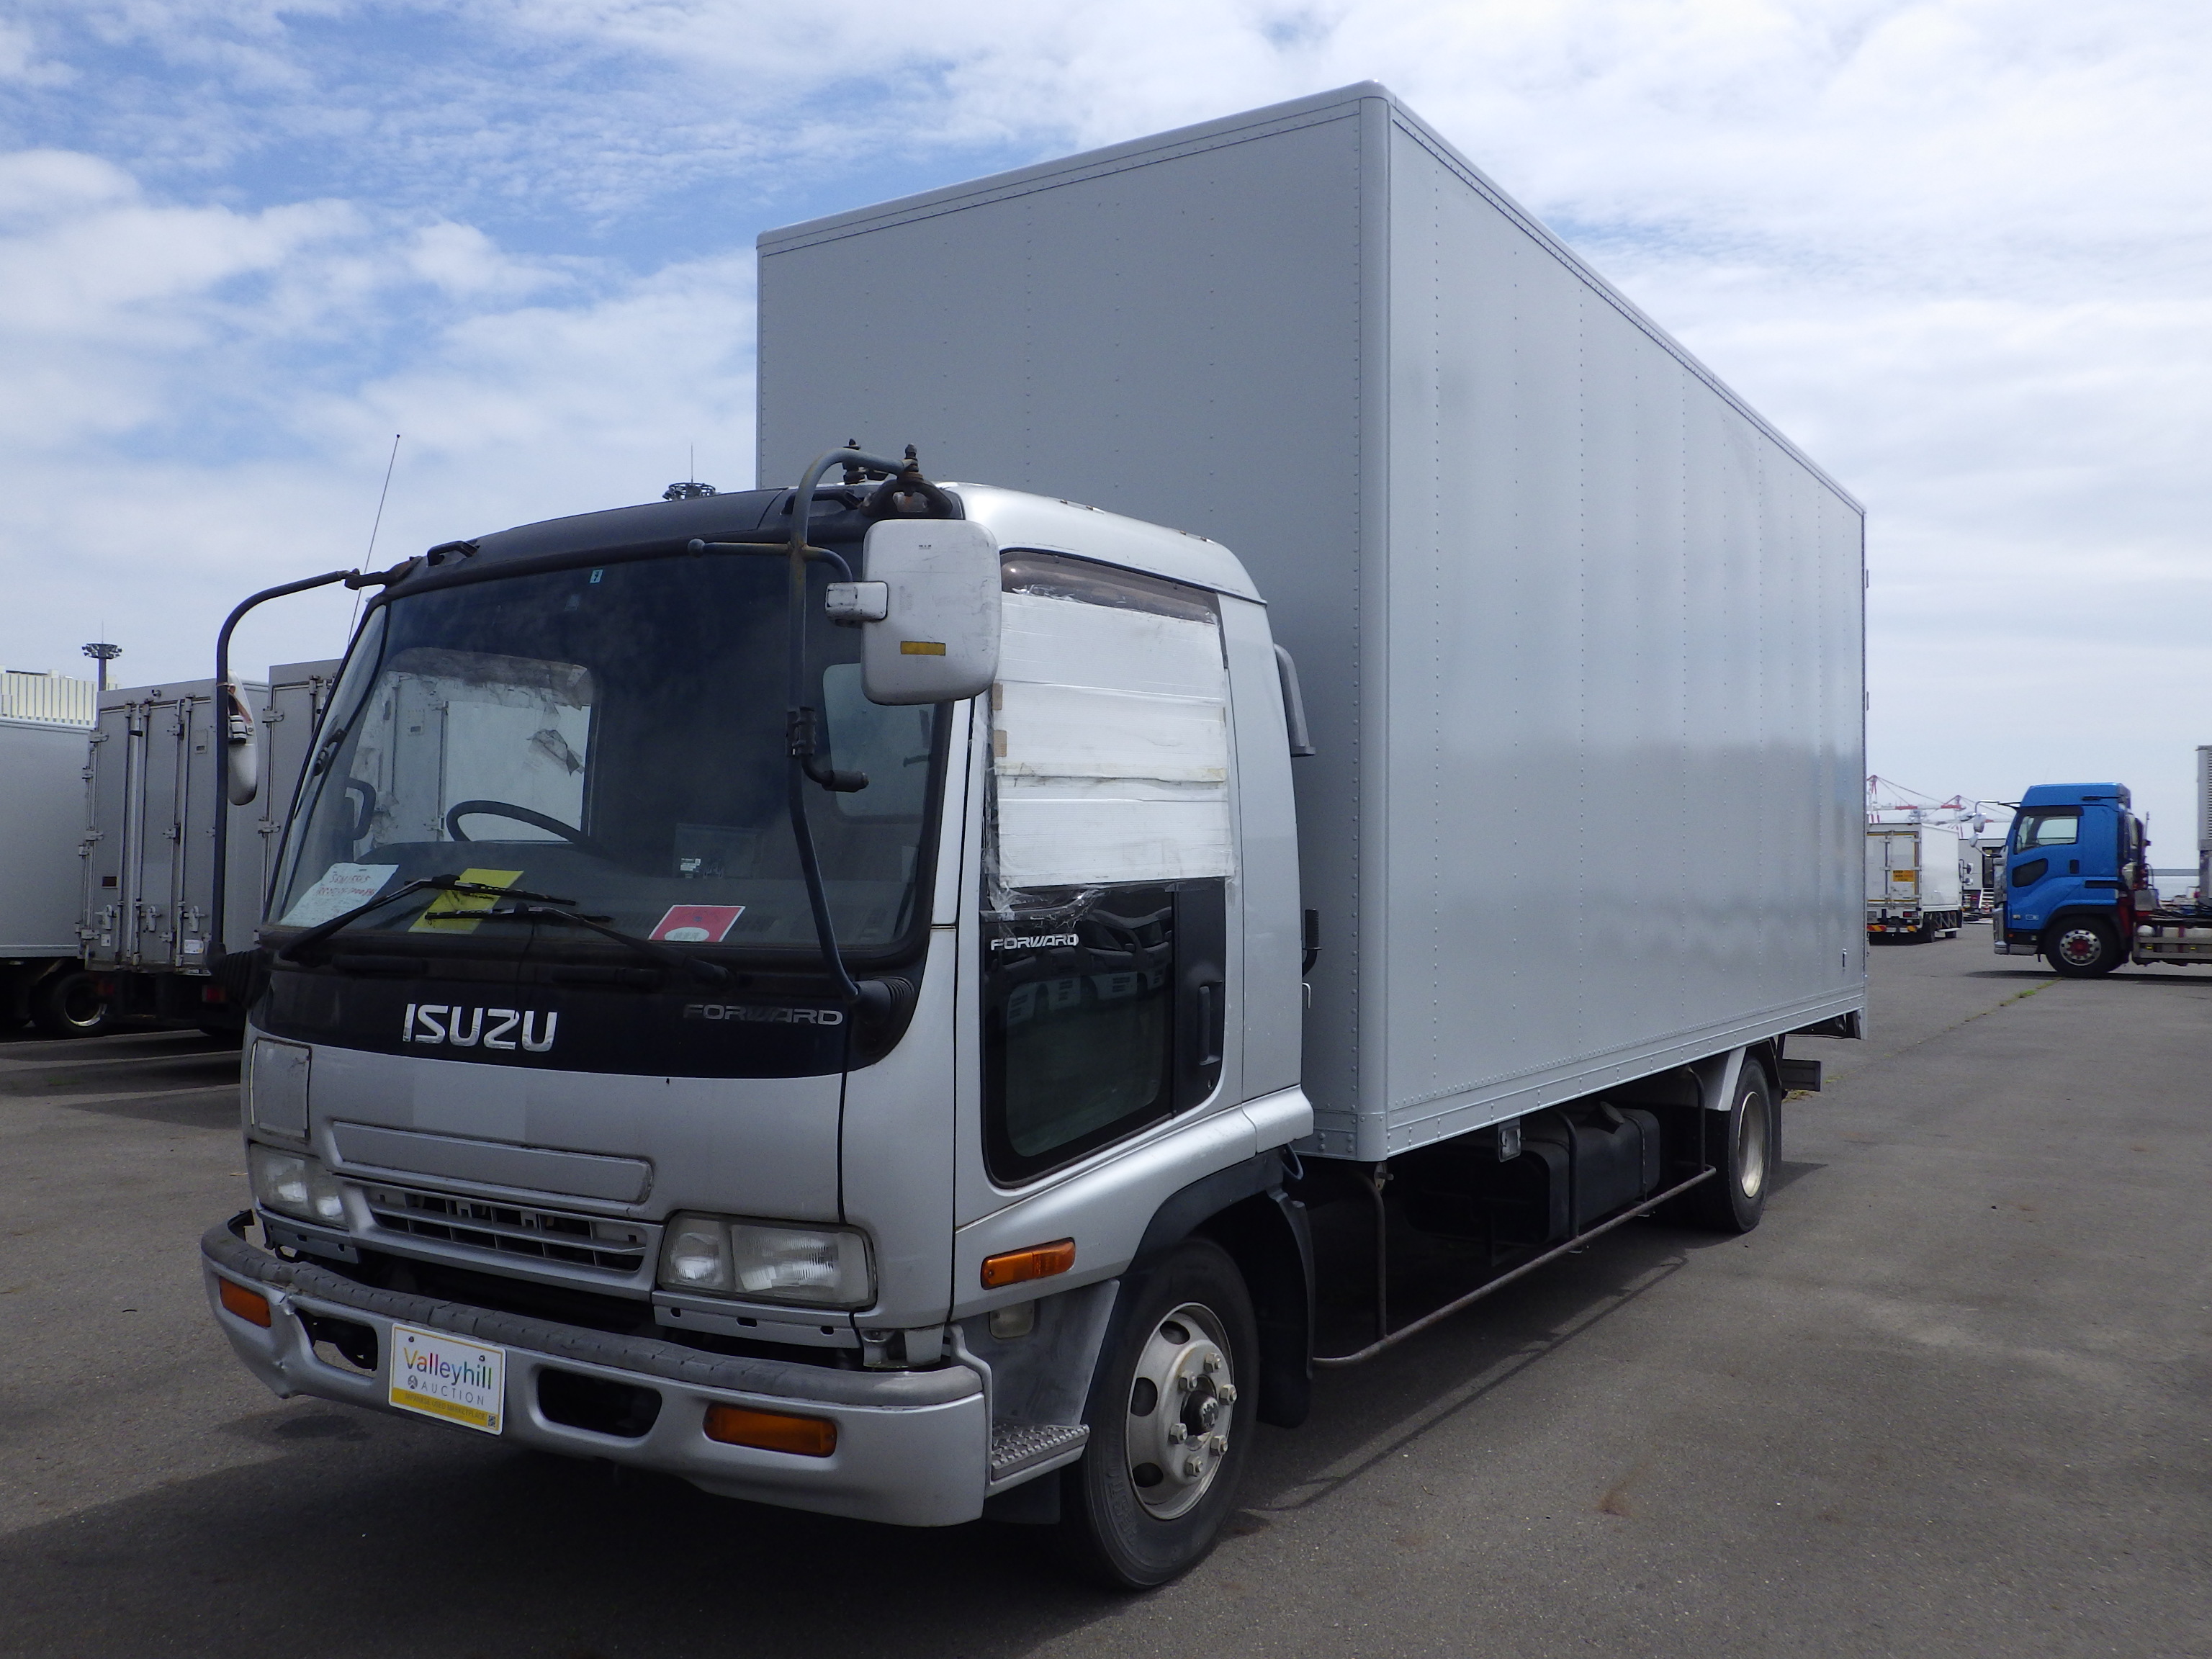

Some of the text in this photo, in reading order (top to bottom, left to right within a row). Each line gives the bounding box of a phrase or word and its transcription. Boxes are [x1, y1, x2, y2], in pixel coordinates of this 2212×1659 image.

[991, 933, 1079, 950] FORWARD
[683, 1004, 843, 1025] FORWARD
[402, 1003, 558, 1053] ISUZU
[403, 1347, 492, 1390] Valleyhill
[421, 1381, 484, 1406] AUCTION
